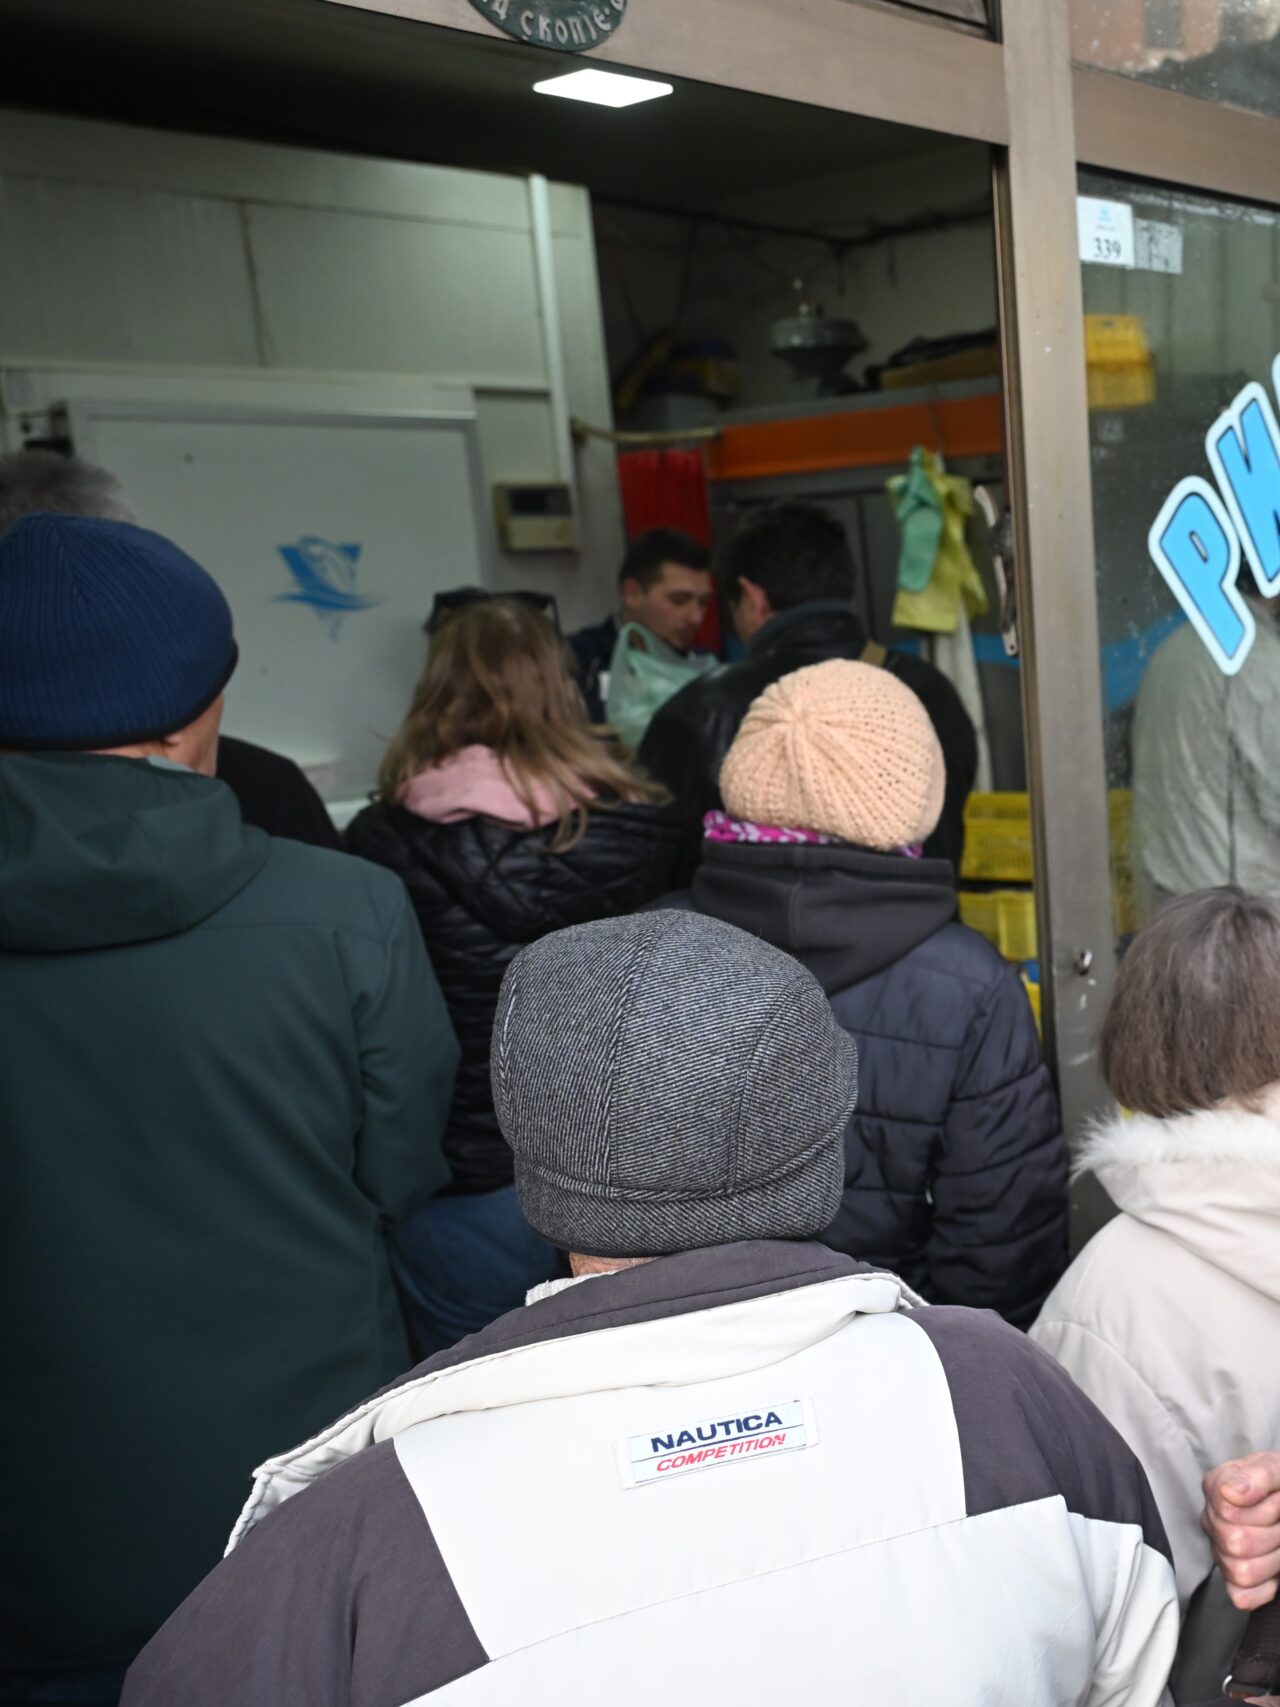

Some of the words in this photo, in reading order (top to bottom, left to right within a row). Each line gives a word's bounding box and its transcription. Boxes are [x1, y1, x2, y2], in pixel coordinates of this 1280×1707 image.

[1094, 237, 1122, 260] 339
[651, 1411, 783, 1453] NAUTICA
[656, 1433, 786, 1472] COMPETITION
